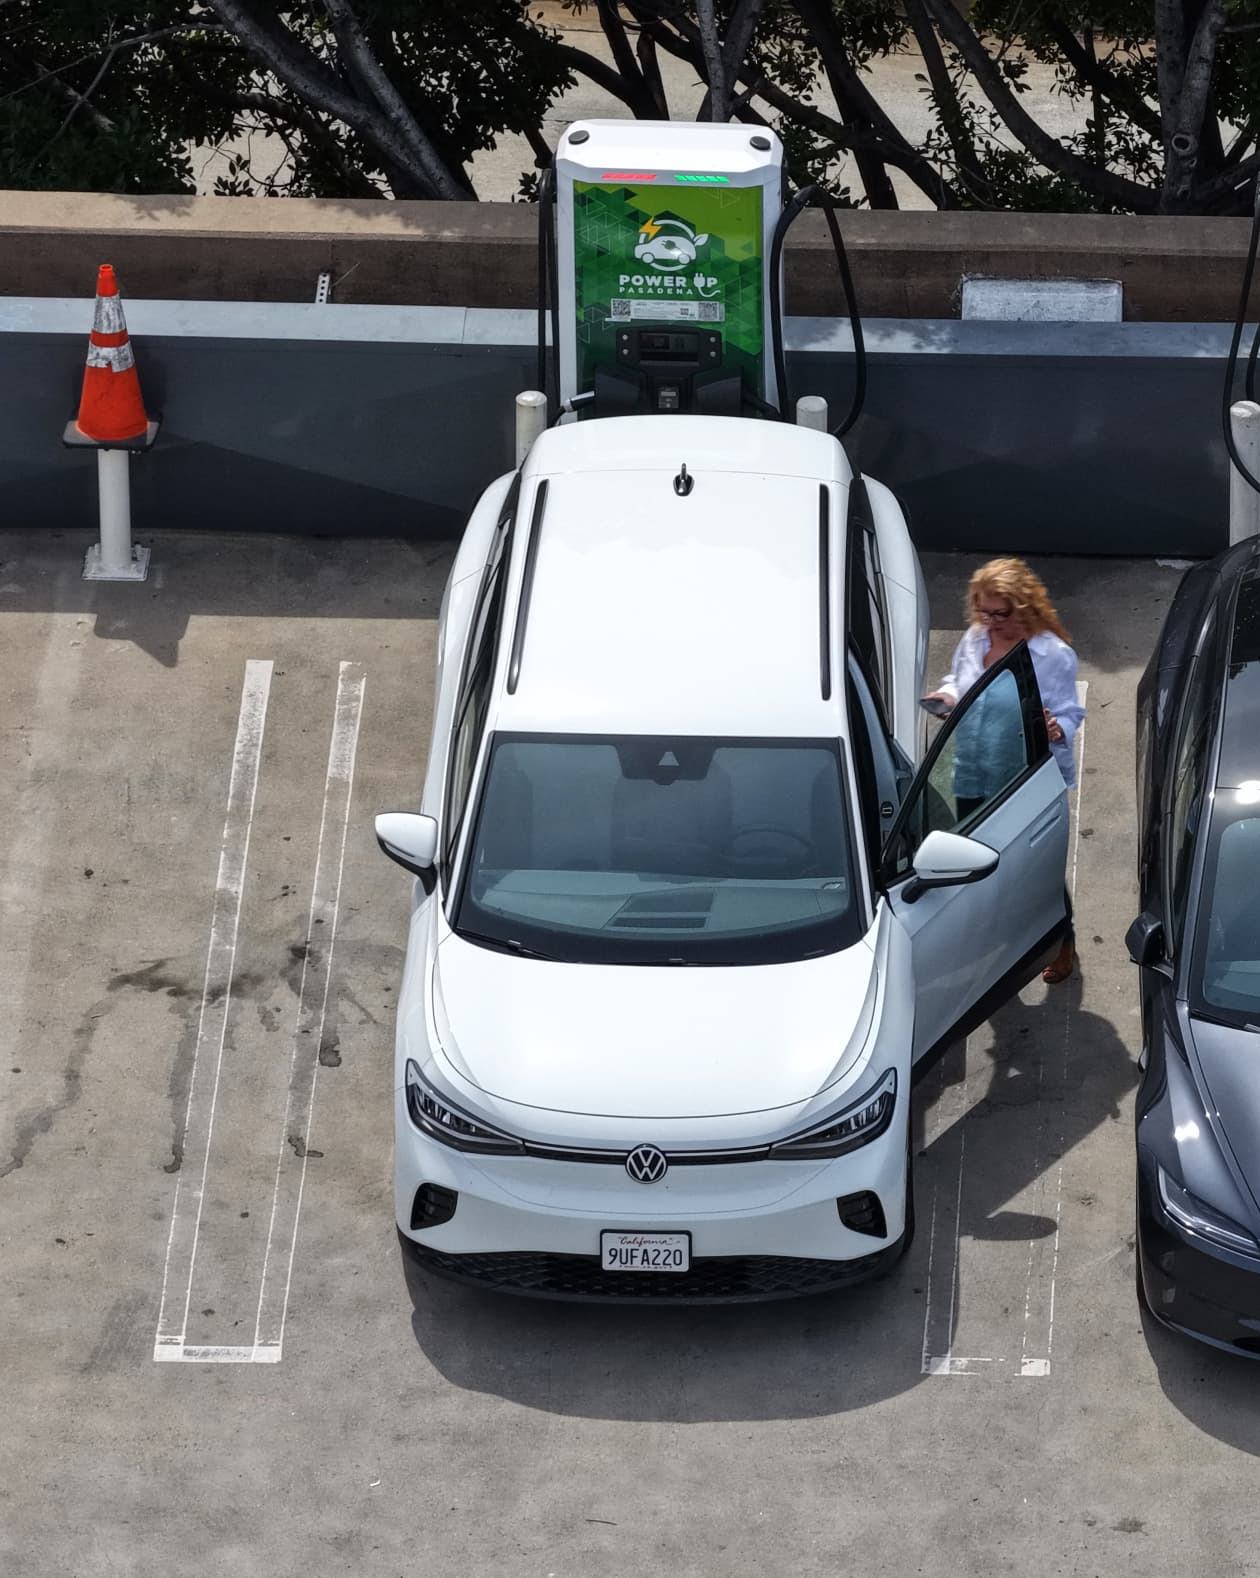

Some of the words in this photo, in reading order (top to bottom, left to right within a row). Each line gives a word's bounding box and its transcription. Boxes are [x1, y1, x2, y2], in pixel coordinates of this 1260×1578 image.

[618, 274, 687, 288] POWER
[619, 286, 694, 295] PASADENA
[620, 1236, 671, 1247] California
[608, 1248, 683, 1266] 9UFA220
